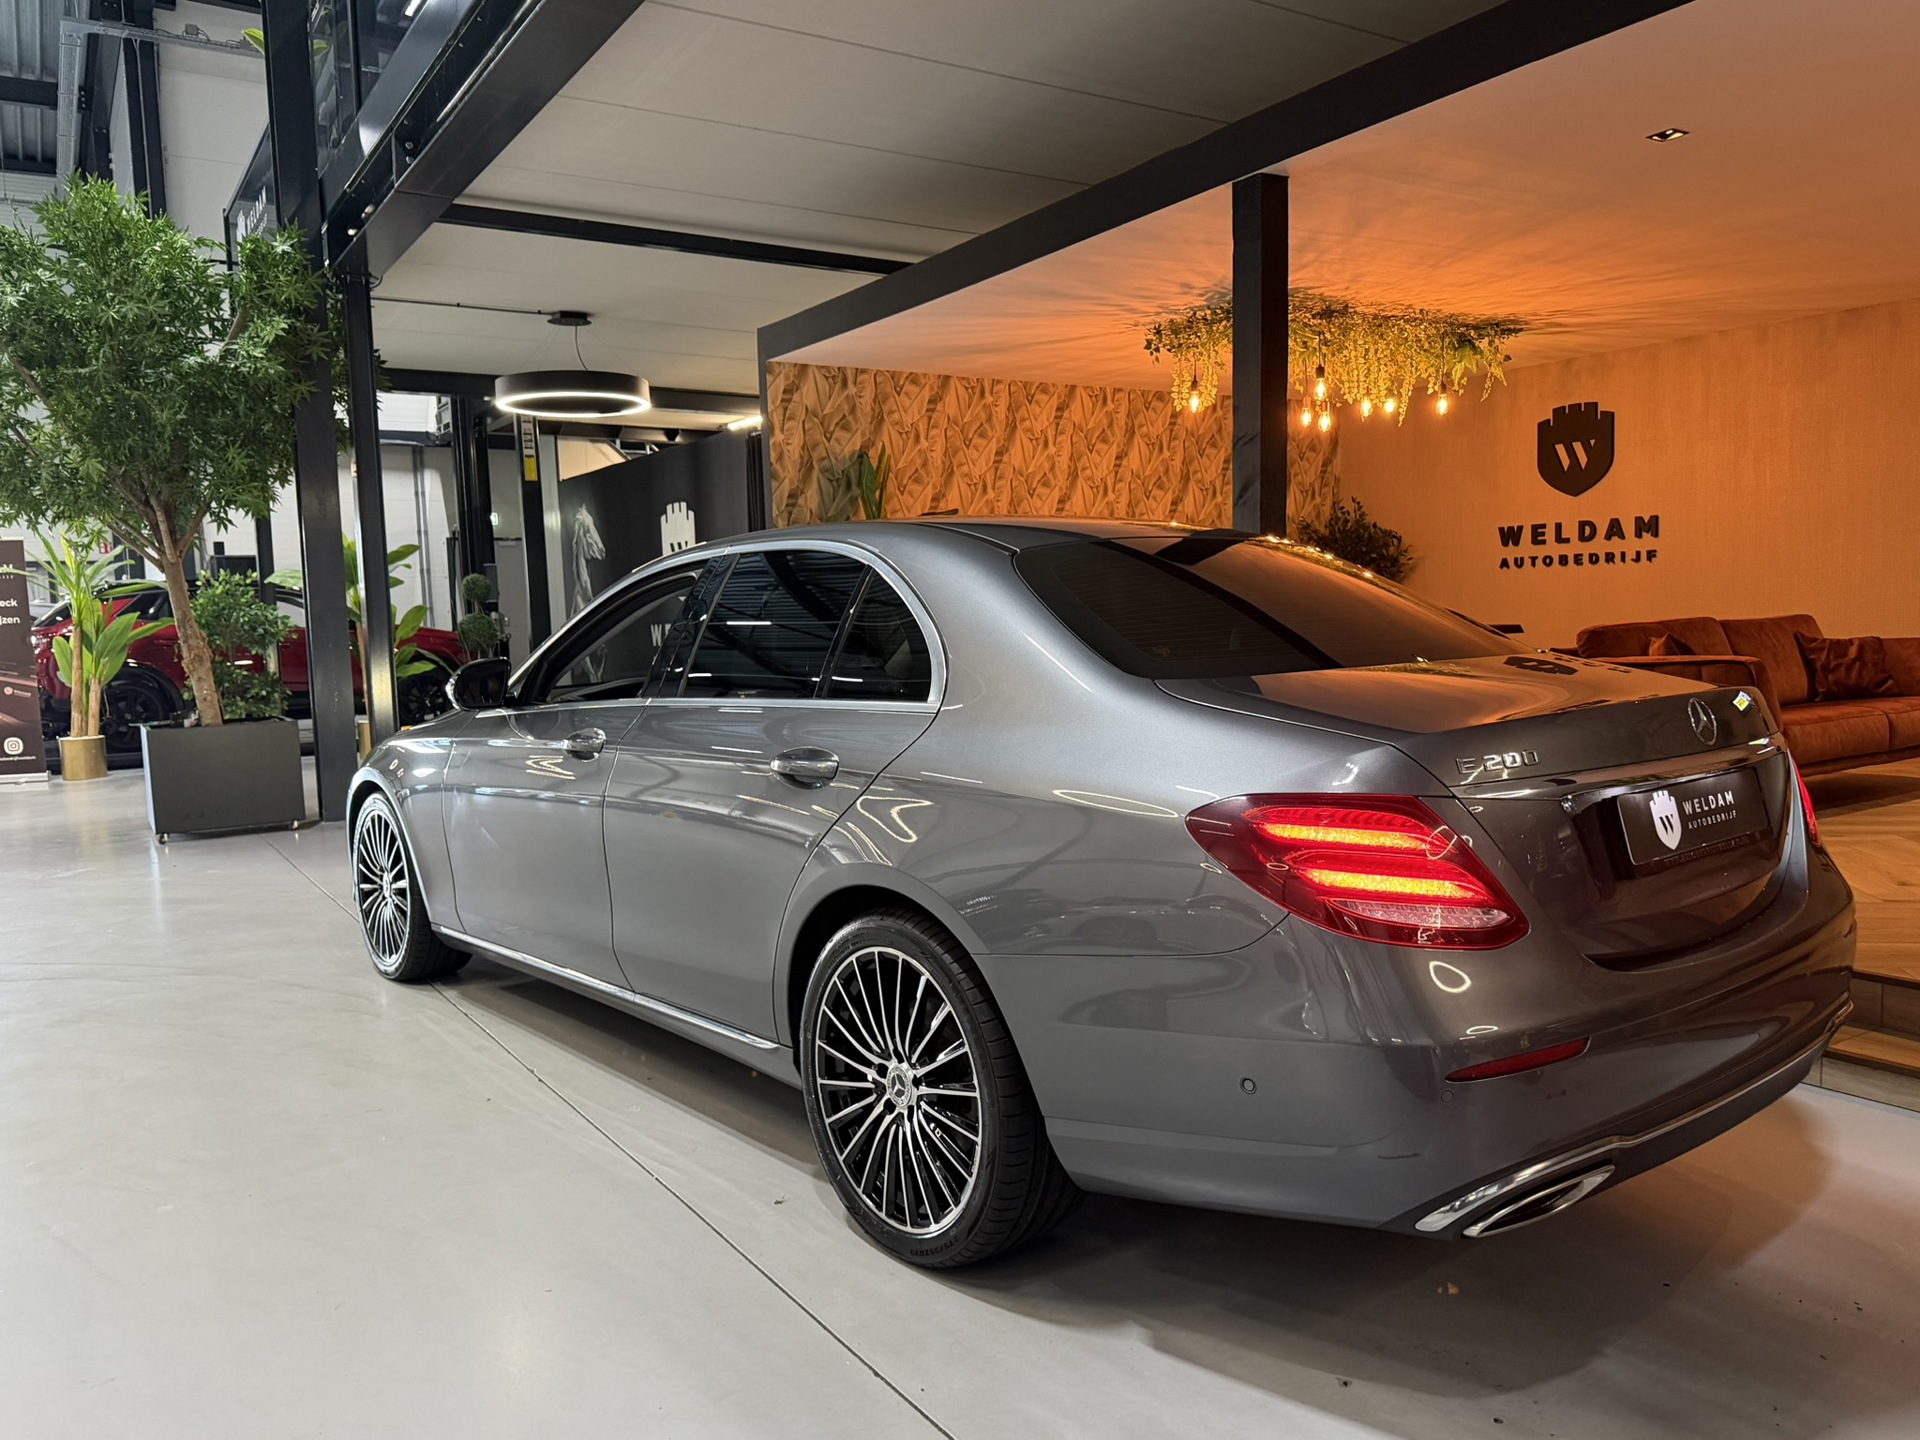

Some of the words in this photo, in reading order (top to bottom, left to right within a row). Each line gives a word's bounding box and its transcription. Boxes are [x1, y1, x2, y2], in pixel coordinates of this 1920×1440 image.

[1498, 515, 1660, 547] WELDAM
[1499, 549, 1658, 569] AUTOBEDRIJF
[1456, 758, 1478, 774] E
[1482, 749, 1541, 771] 200
[1682, 790, 1734, 815] WELDAM
[1688, 809, 1737, 830] AUTOBEDRIJF
